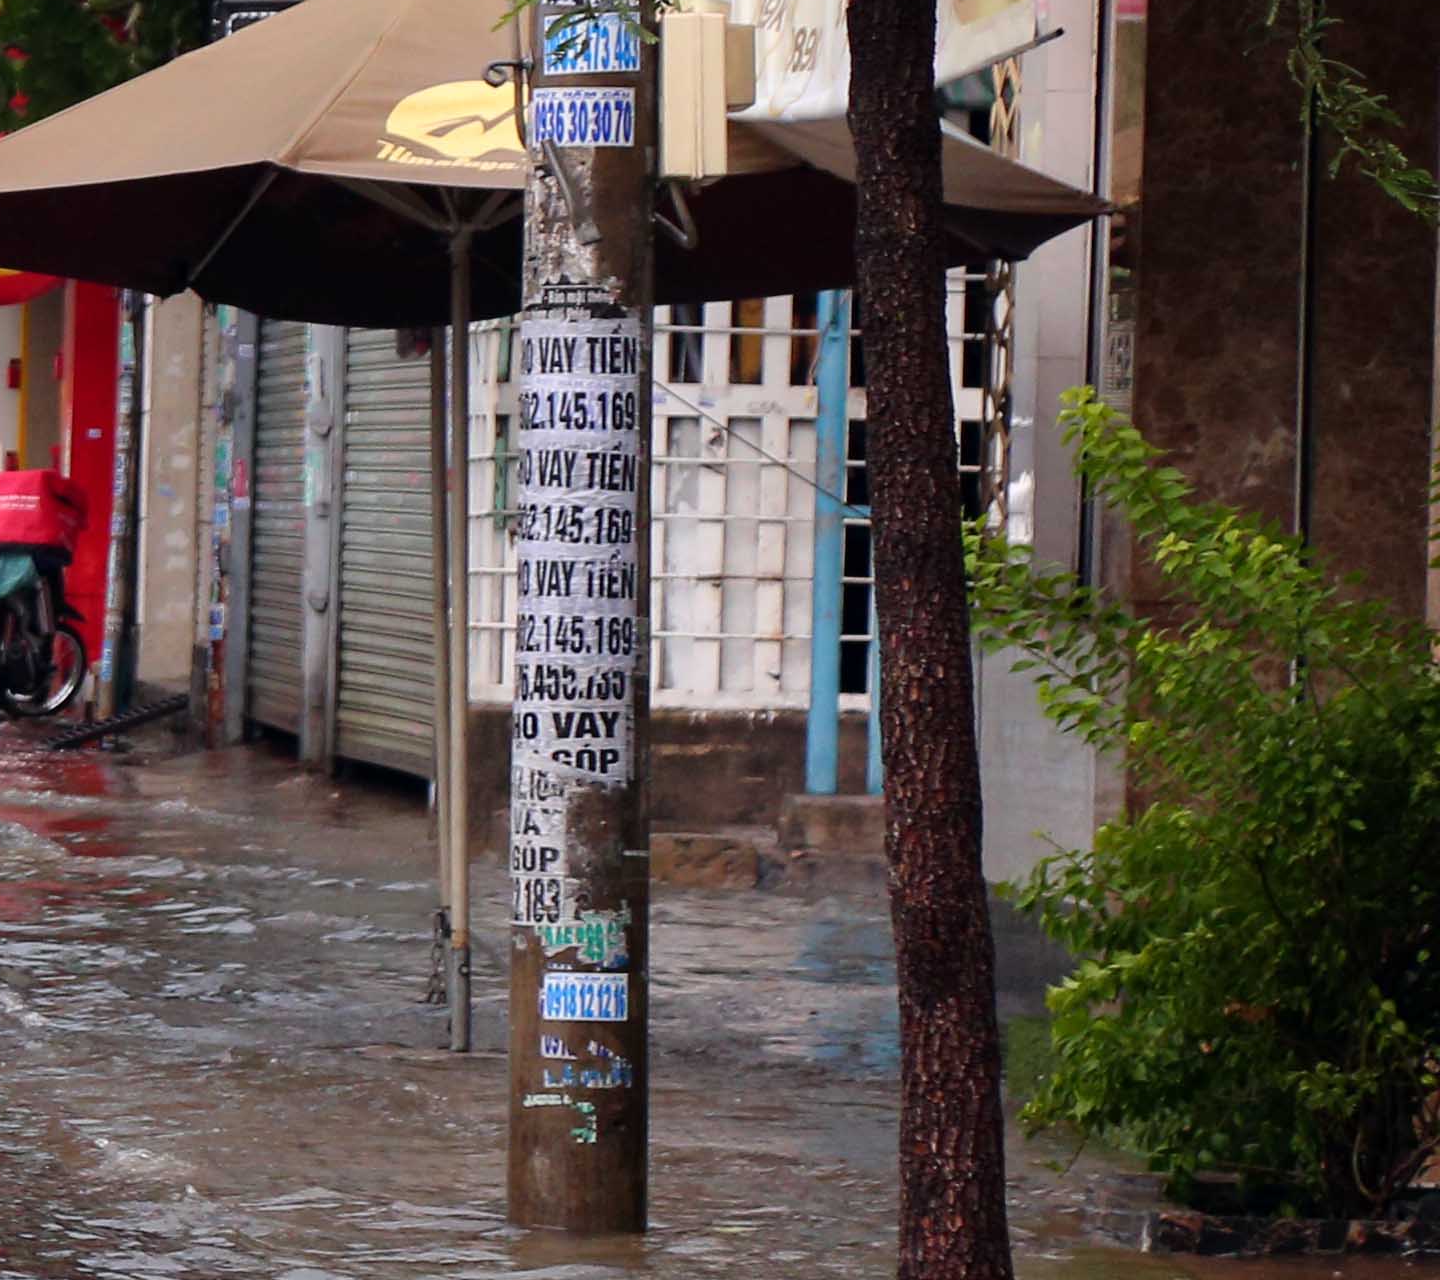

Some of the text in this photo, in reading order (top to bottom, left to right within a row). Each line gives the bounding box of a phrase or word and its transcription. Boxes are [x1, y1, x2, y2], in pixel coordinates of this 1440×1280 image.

[539, 336, 577, 375] VAY
[538, 449, 577, 489] VAY
[536, 559, 575, 598] VAY
[551, 711, 621, 739] VAY
